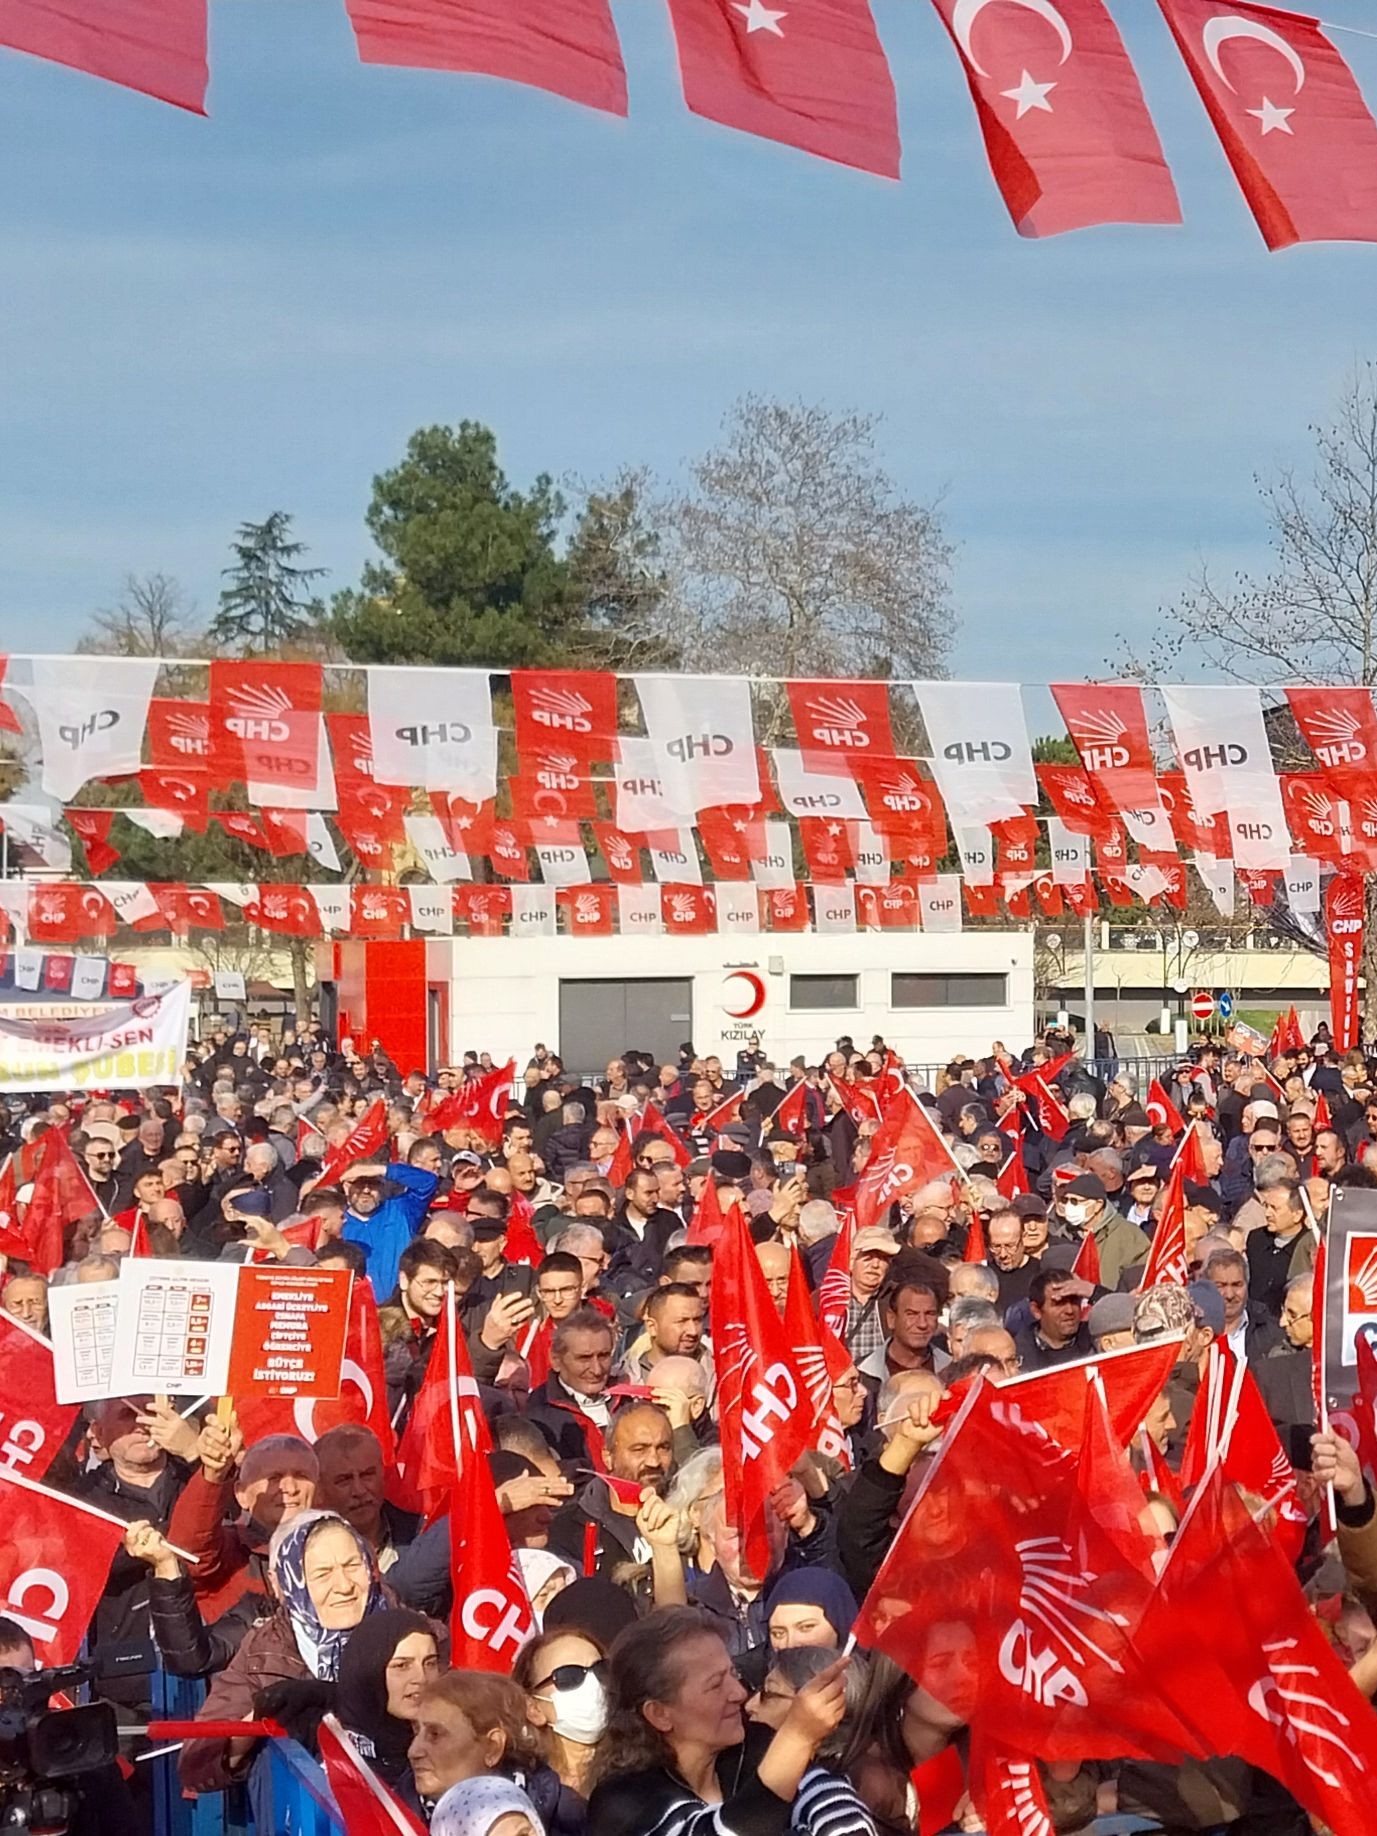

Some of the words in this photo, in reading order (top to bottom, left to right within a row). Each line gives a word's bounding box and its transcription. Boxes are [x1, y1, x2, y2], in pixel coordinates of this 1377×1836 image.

[1289, 884, 1314, 897] CHP
[929, 899, 955, 911] CHP
[363, 907, 388, 920] CHP
[418, 906, 446, 918] CHP
[519, 911, 549, 924] CHP
[576, 911, 600, 924] CHP
[629, 911, 657, 923] CHP
[672, 910, 696, 923] CHP
[726, 911, 754, 923] CHP
[825, 908, 853, 921] CHP
[1331, 919, 1362, 934] CHP
[733, 1021, 754, 1029] TÜRK
[720, 1029, 767, 1042] KIZILAY
[267, 1357, 304, 1369] BÜTÇE
[0, 1417, 46, 1477] CH
[462, 1587, 536, 1660] CH
[999, 1617, 1089, 1707] CHP
